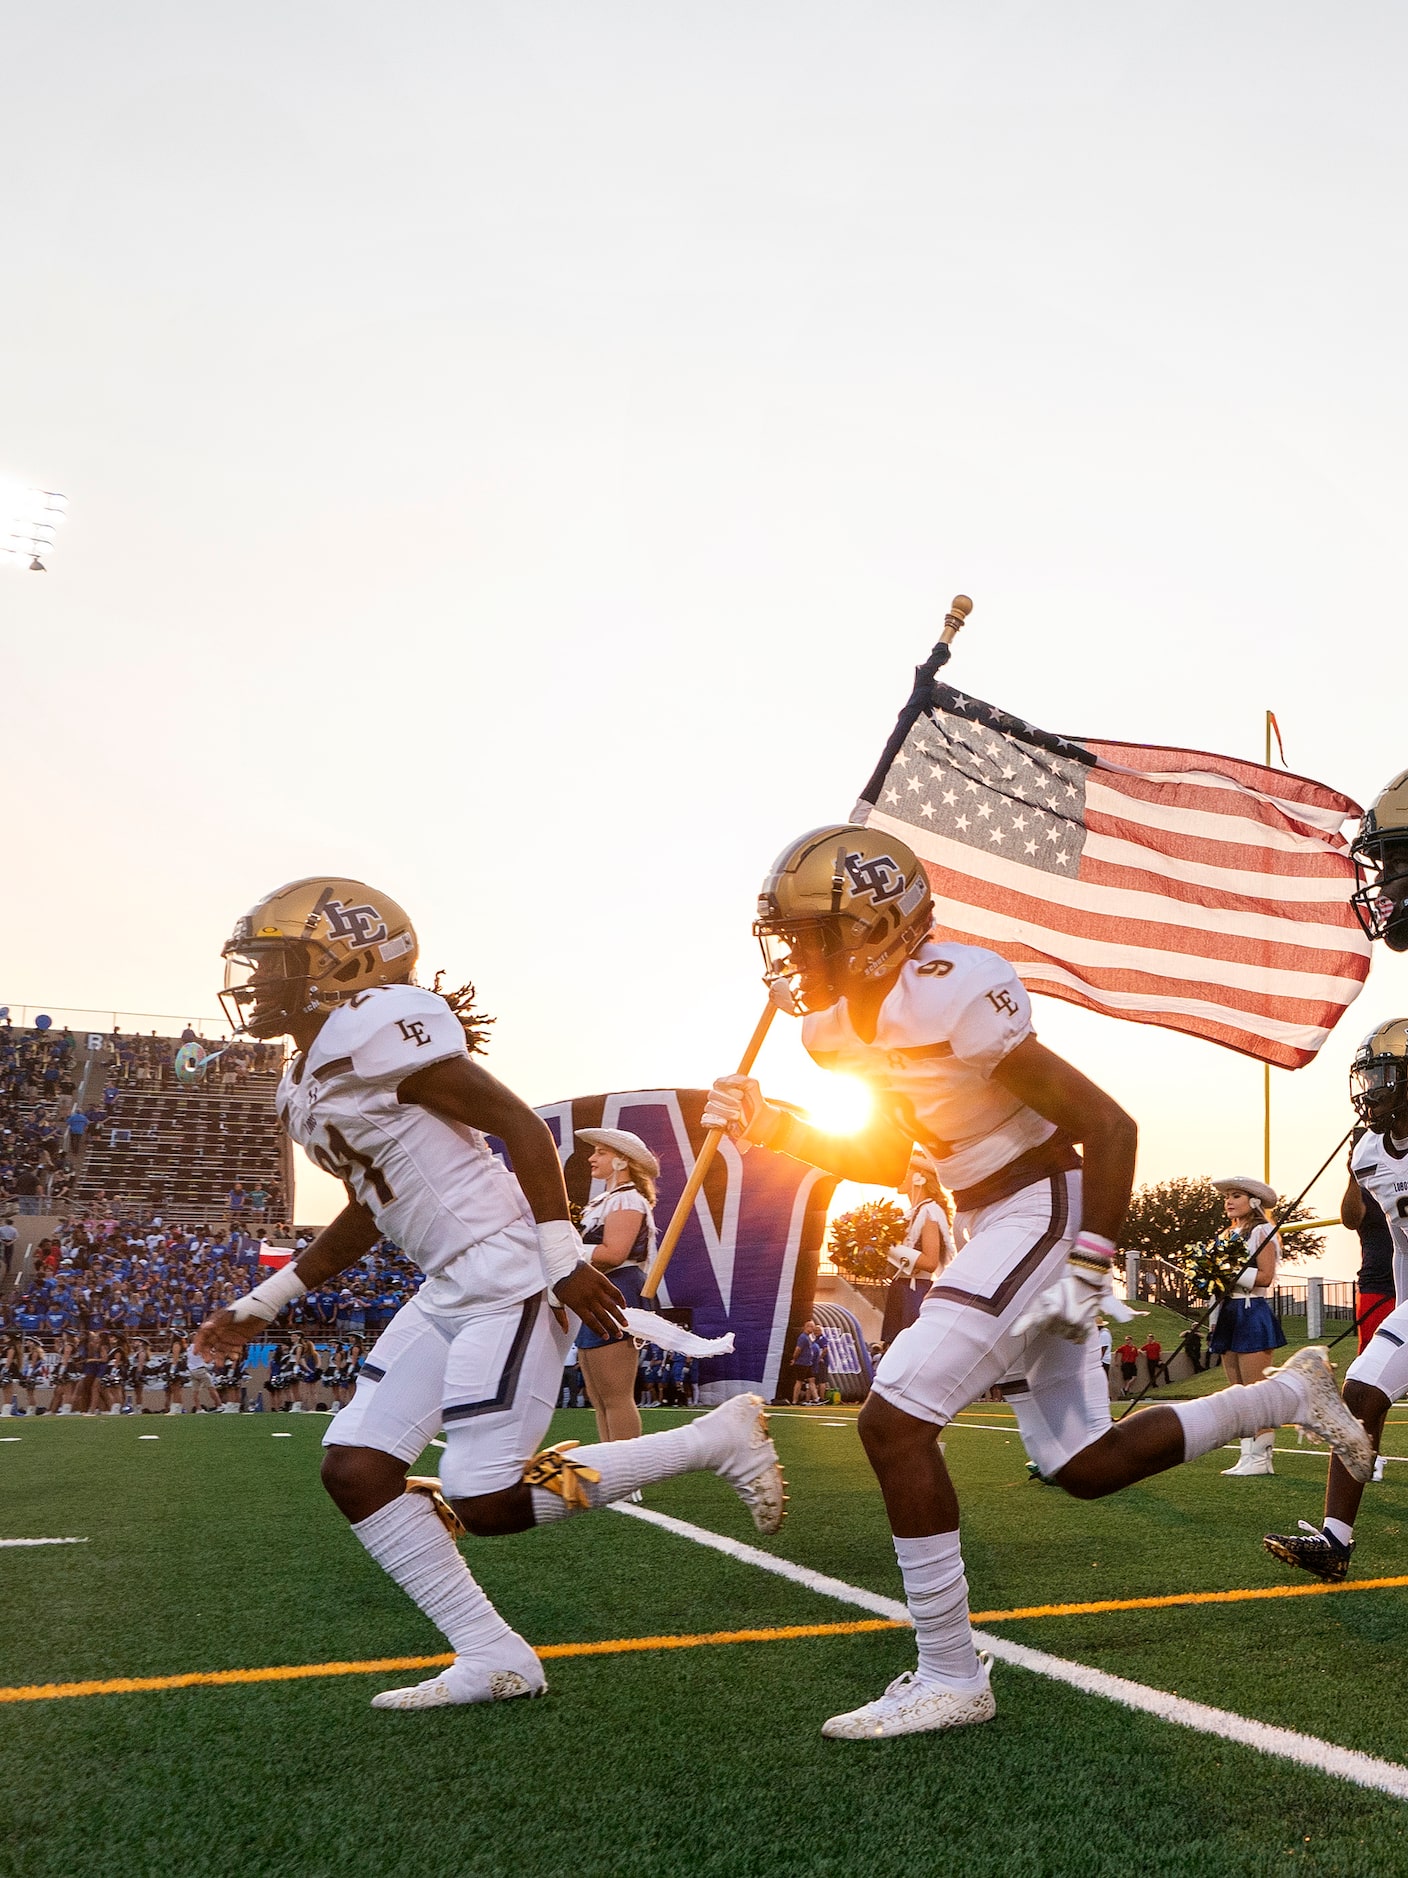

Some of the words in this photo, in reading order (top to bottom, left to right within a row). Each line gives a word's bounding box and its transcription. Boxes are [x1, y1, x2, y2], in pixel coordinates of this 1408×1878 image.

[835, 852, 906, 906] LE
[322, 900, 388, 950] LE
[986, 989, 1019, 1017] LE
[87, 1033, 103, 1050] B
[394, 1018, 432, 1047] LE
